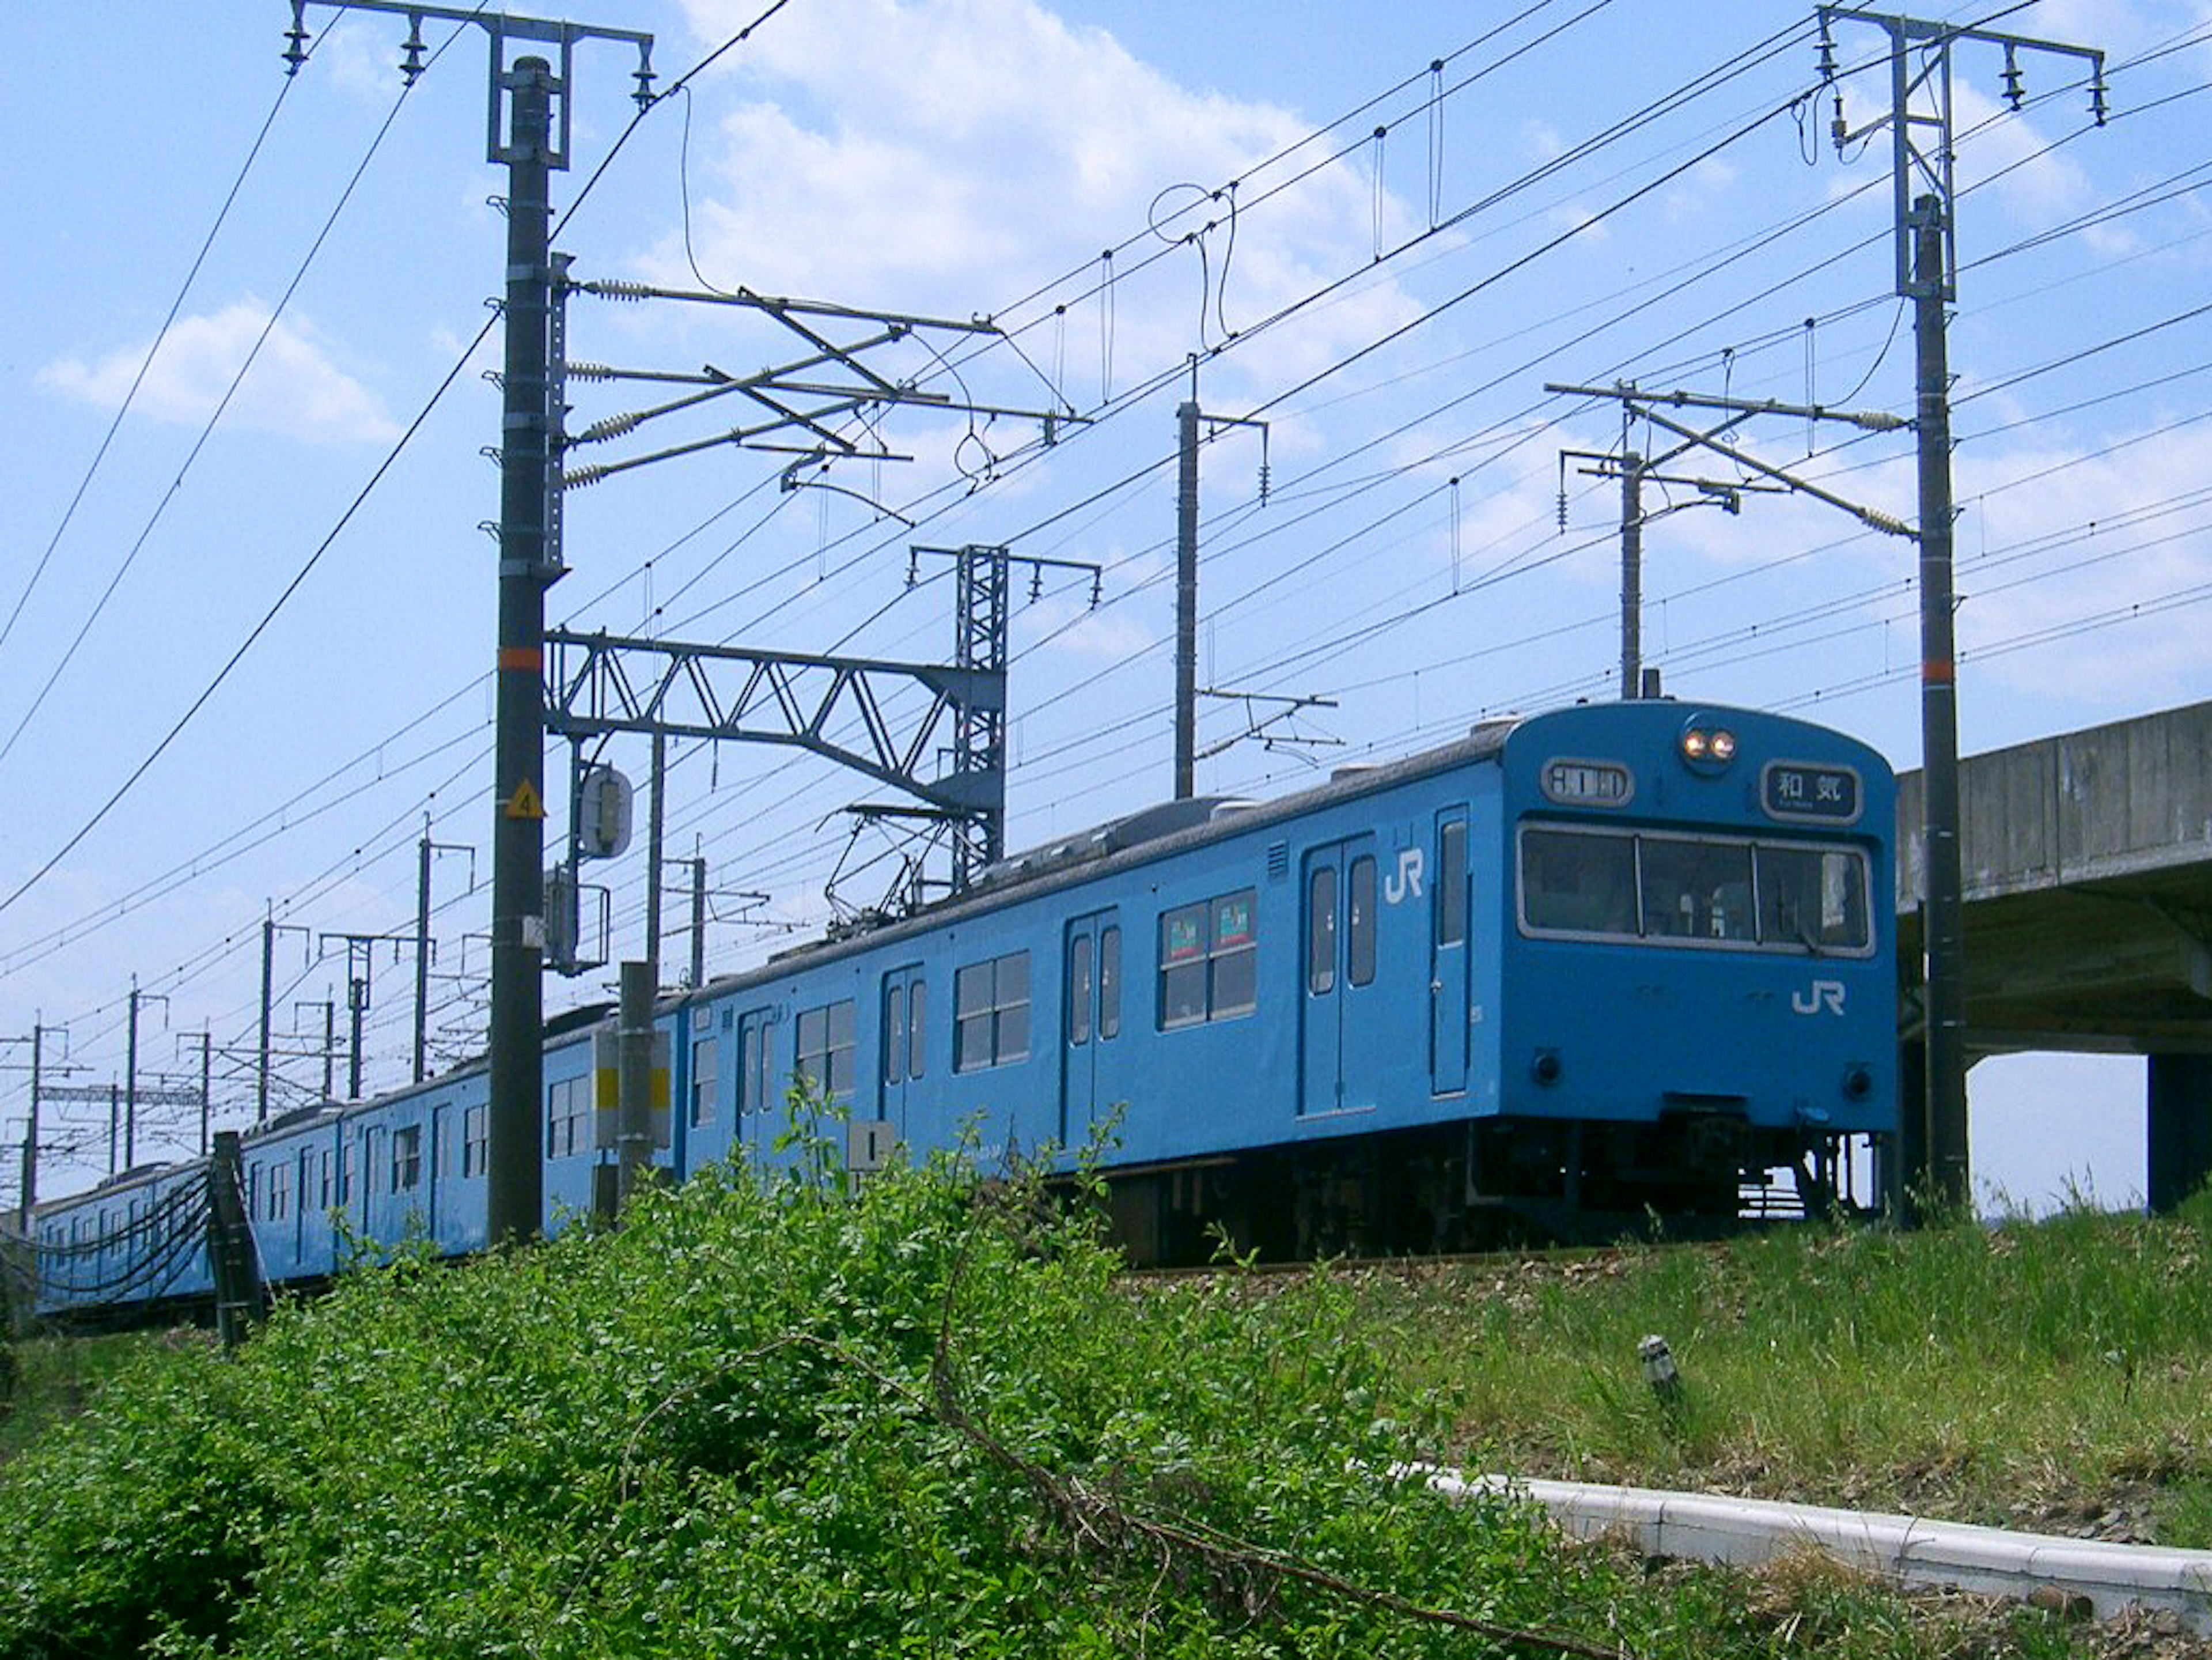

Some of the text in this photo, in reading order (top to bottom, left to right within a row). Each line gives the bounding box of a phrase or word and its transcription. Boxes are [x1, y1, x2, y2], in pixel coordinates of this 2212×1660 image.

[1778, 772, 1842, 801] 和気
[1385, 848, 1423, 904] JR
[1792, 979, 1845, 1016] JR
